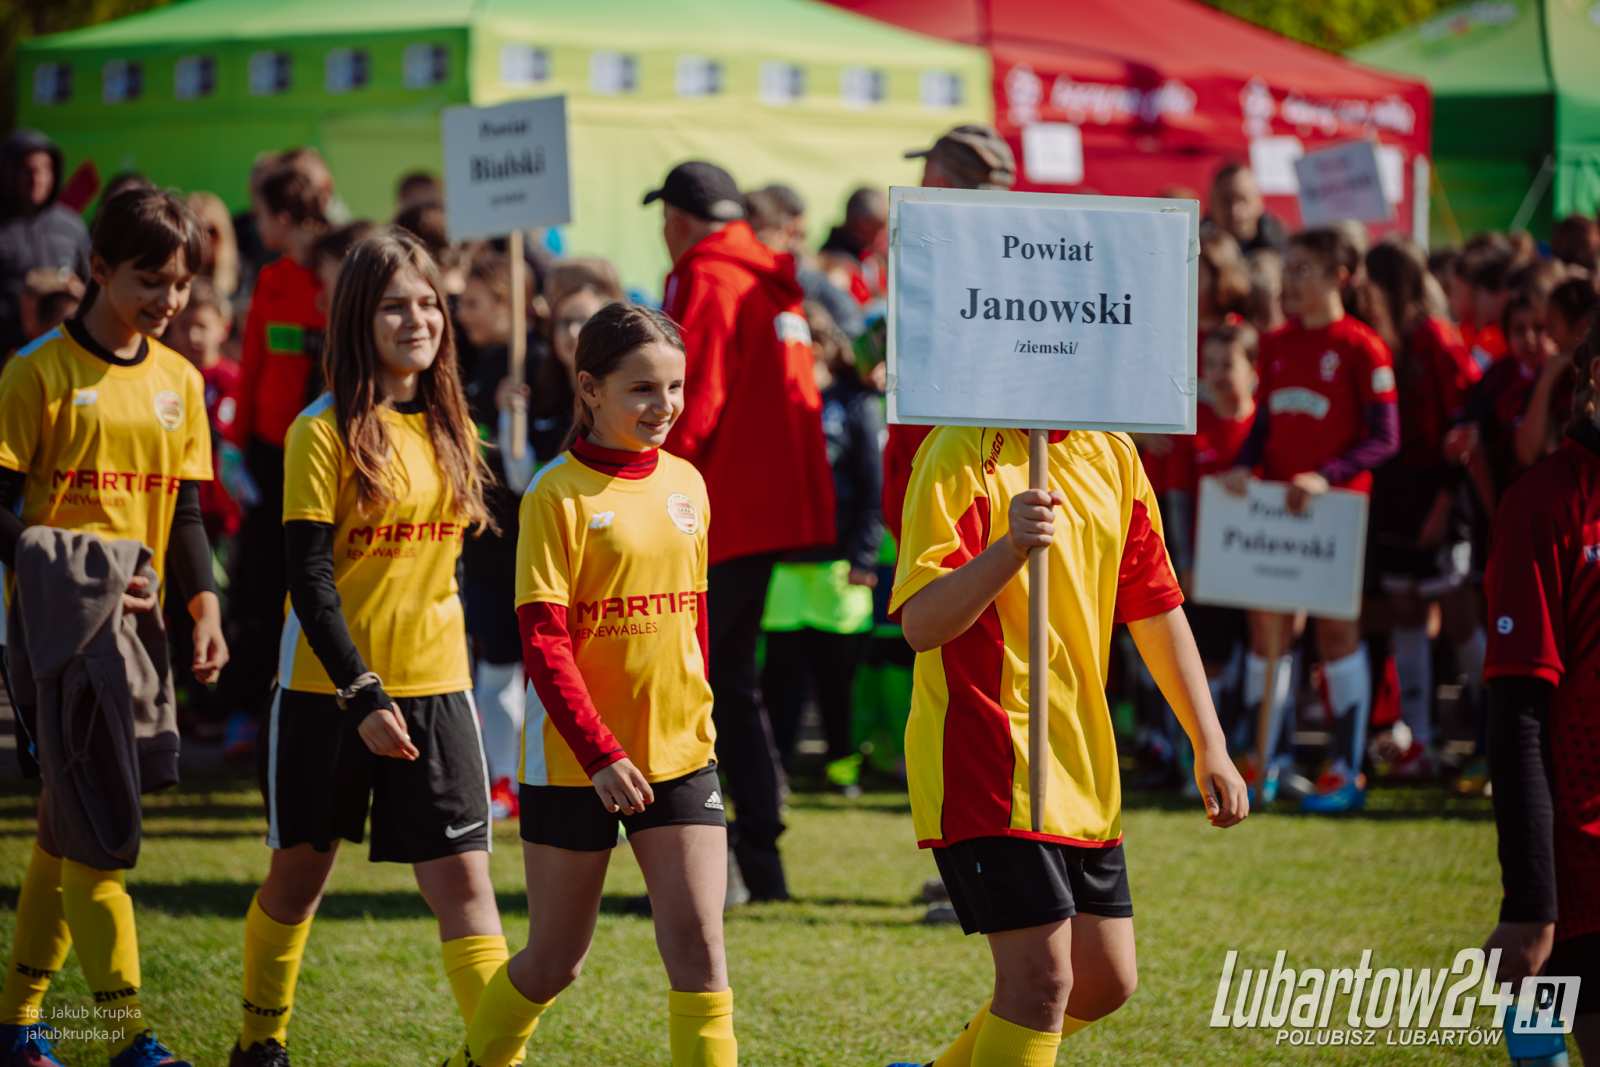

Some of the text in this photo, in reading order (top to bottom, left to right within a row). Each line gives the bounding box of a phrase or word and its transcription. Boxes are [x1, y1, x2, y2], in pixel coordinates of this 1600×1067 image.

[1002, 235, 1094, 262] Powiat
[960, 287, 1133, 325] Janowski
[1013, 340, 1079, 355] /ziemski/
